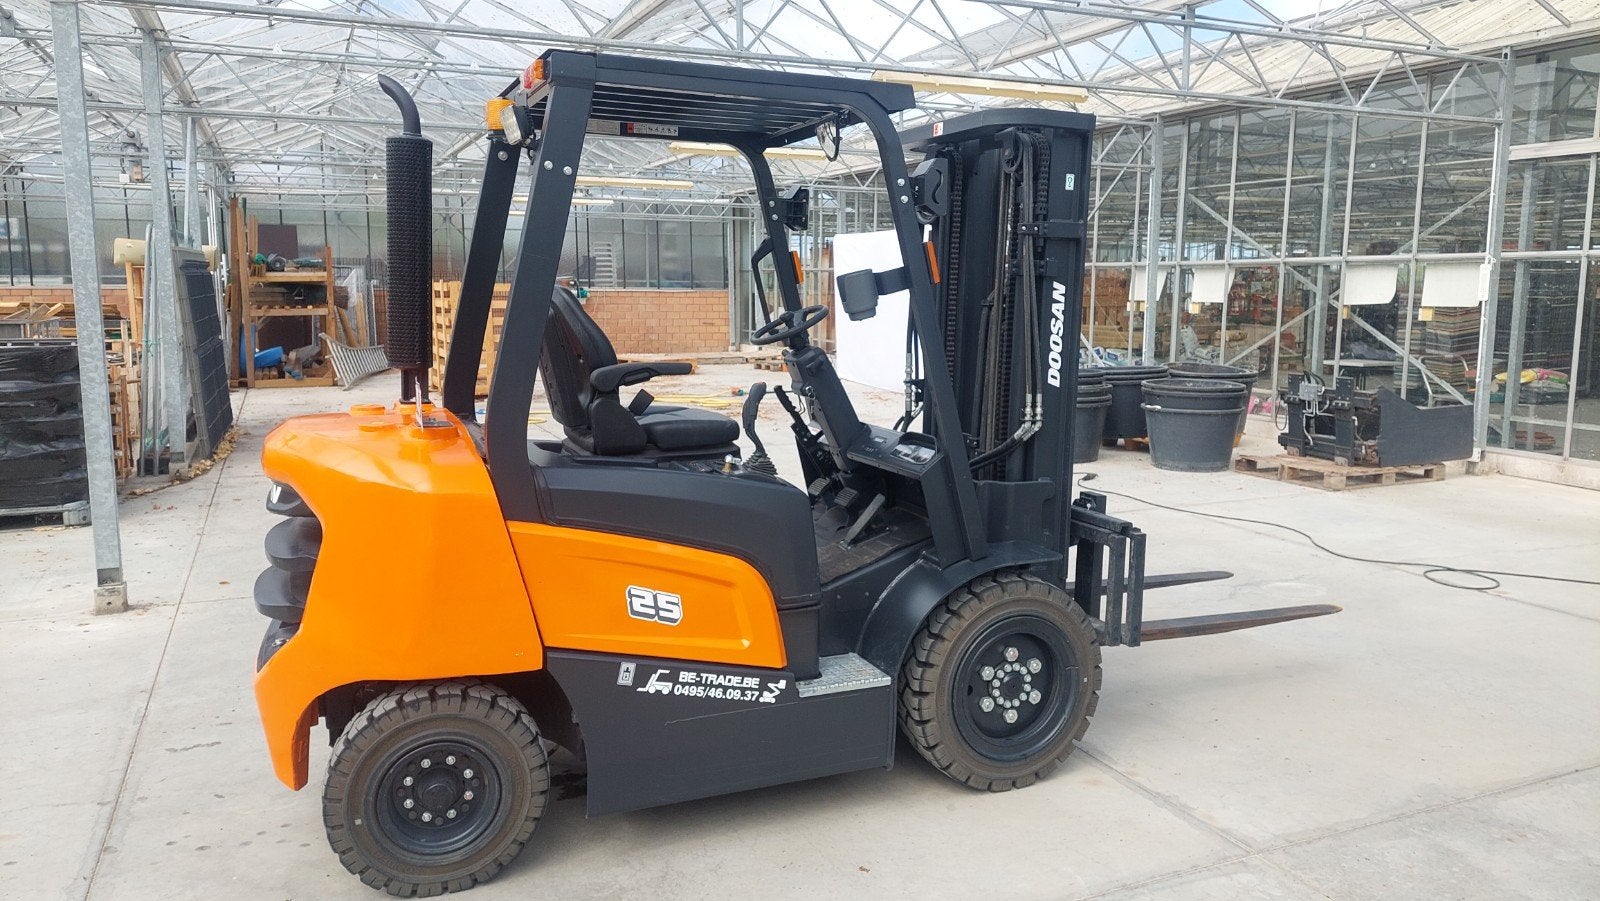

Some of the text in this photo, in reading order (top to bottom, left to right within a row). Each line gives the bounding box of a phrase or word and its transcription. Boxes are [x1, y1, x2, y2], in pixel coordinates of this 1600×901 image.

[1047, 281, 1066, 388] DOOSAN
[626, 585, 683, 626] 25
[673, 684, 759, 701] 0495/46.09.37
[678, 671, 760, 689] BE-TRADE.BE
